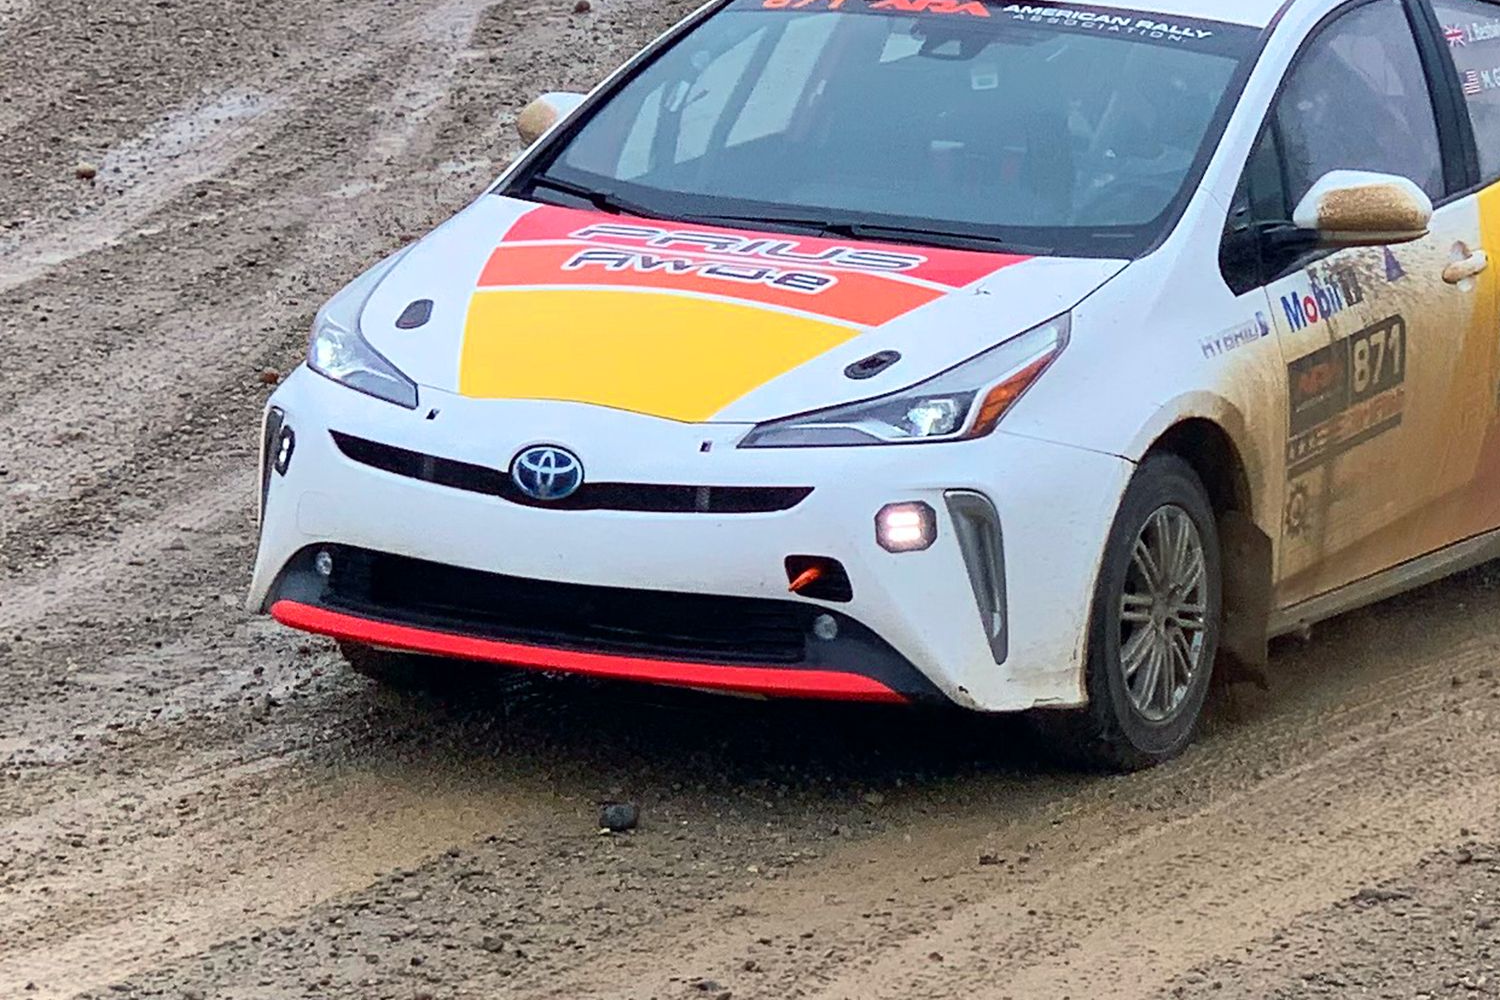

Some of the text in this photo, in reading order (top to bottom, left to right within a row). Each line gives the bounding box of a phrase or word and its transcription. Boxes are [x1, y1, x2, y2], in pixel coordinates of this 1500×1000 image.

[1003, 4, 1213, 39] AMERICAN RALLY
[1012, 14, 1182, 42] ASSOCIATION
[570, 225, 925, 270] PRIUS
[1353, 323, 1401, 393] 871
